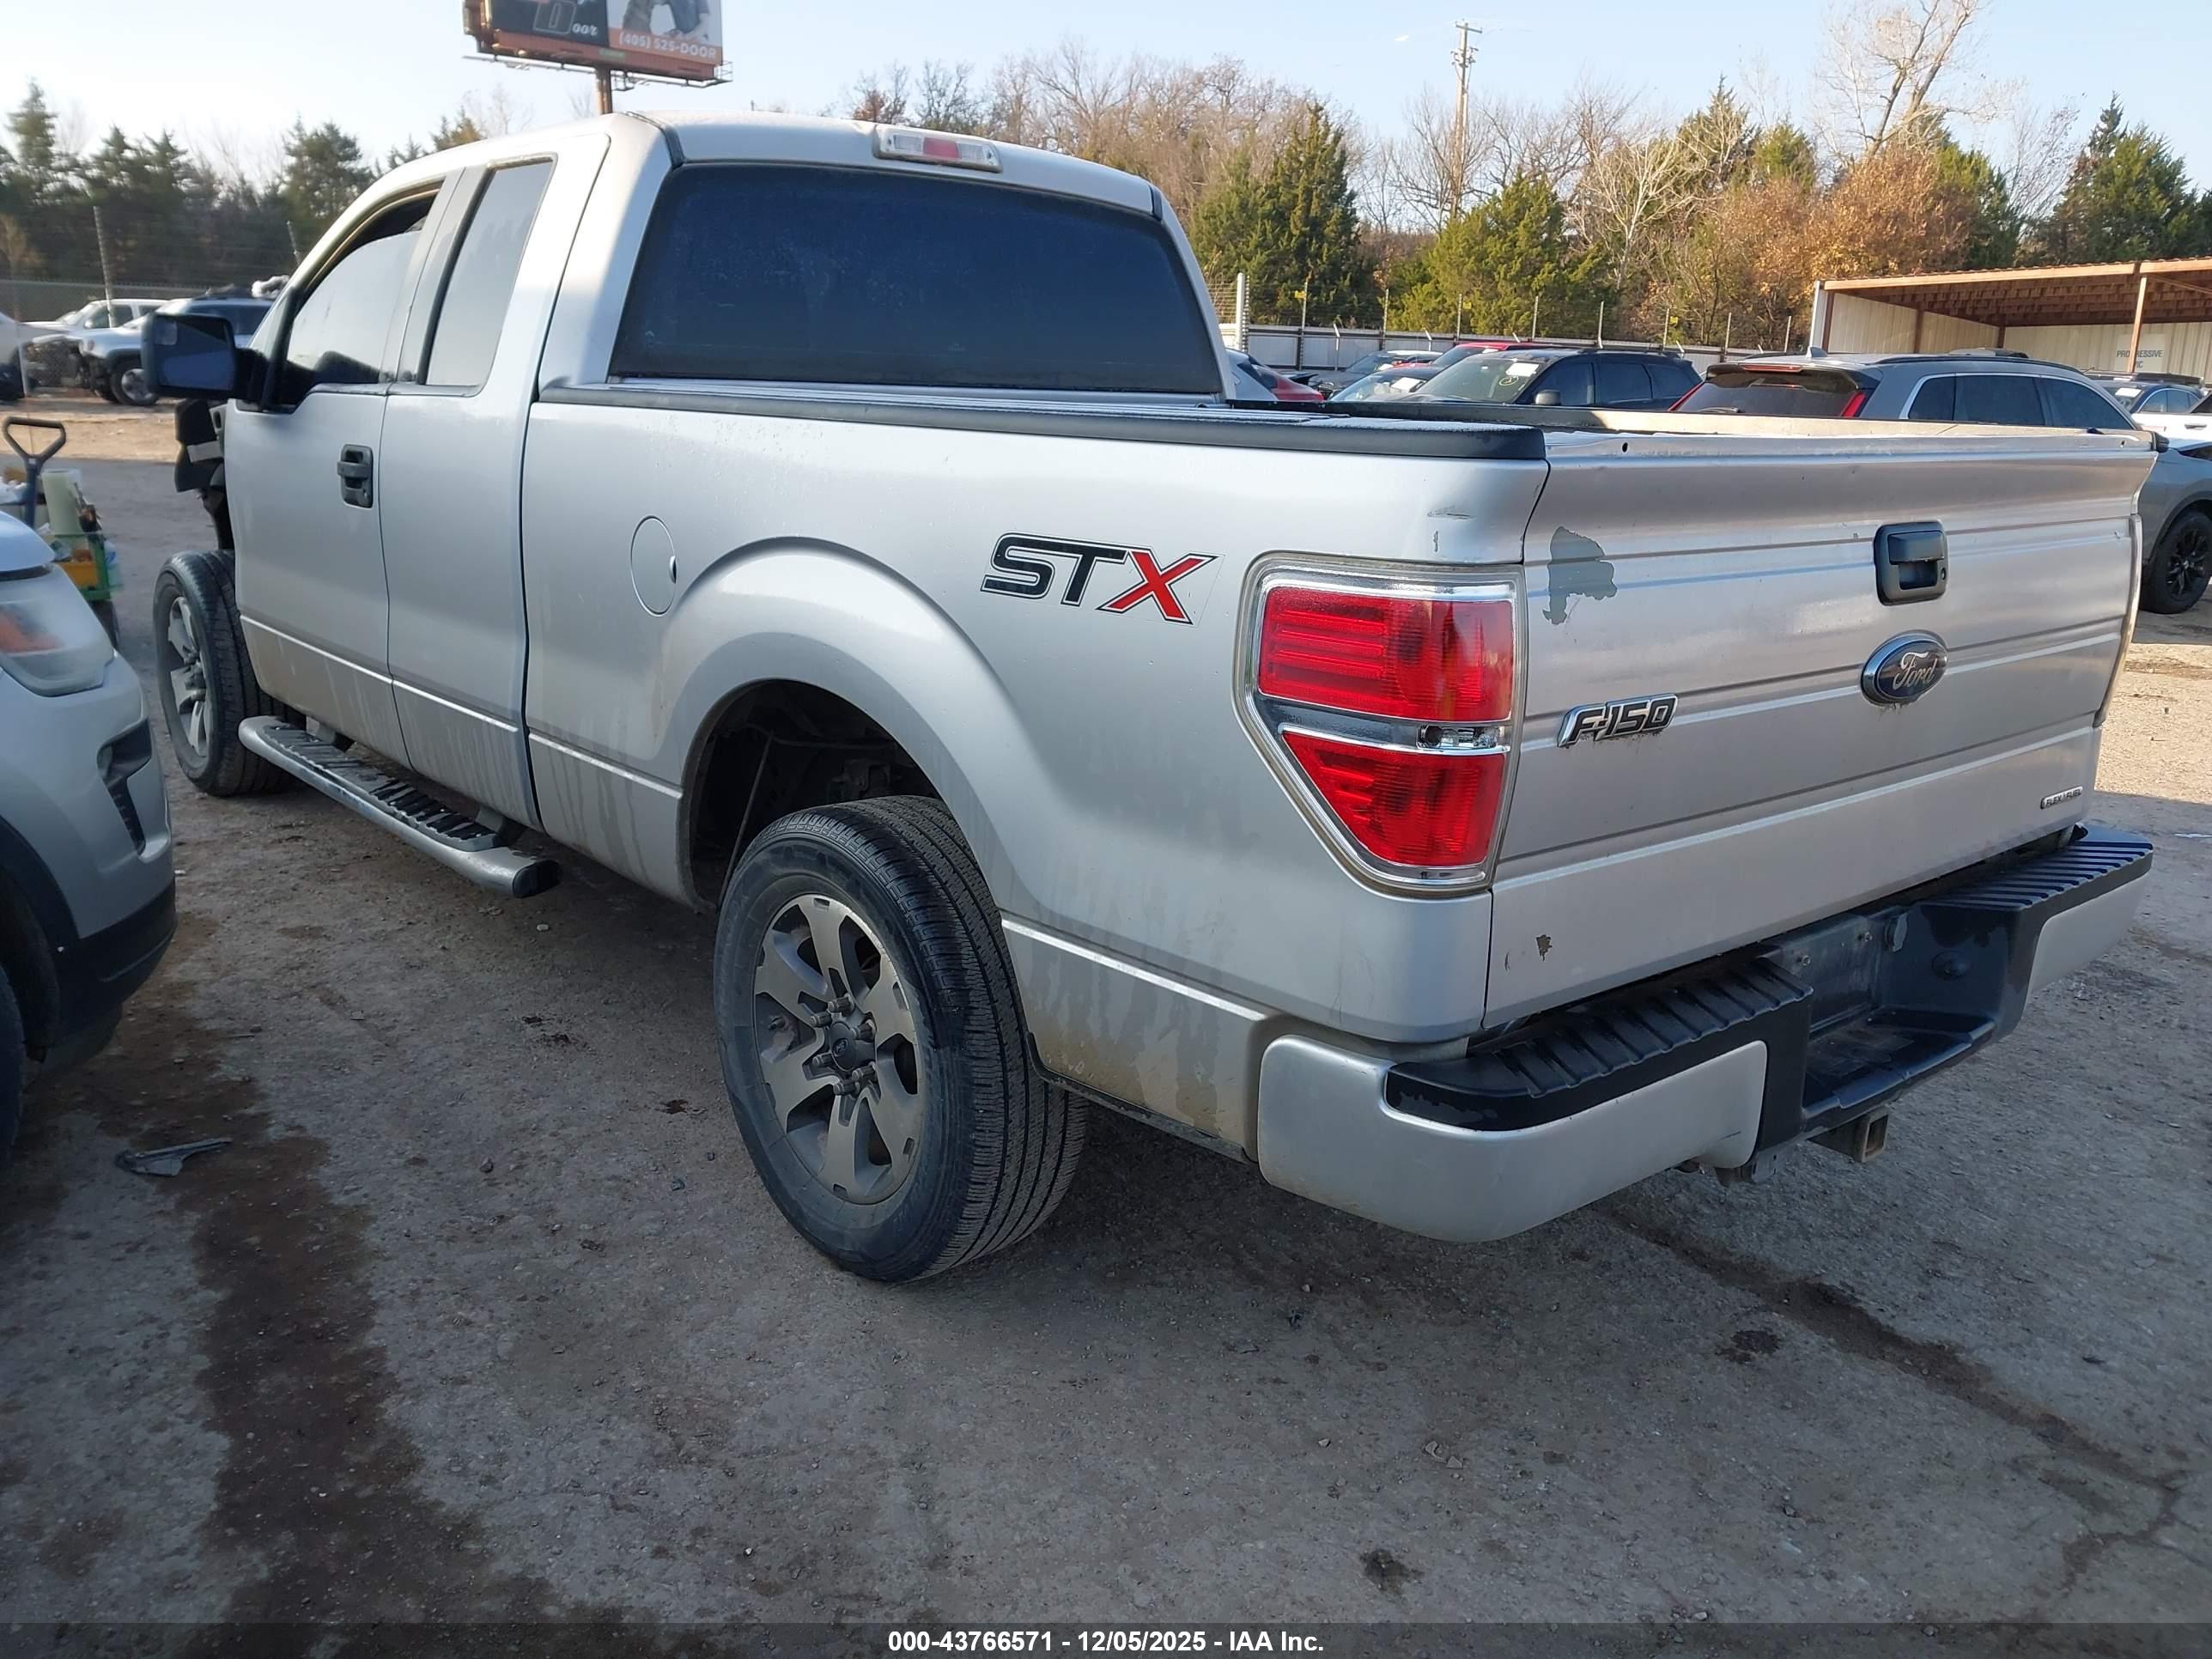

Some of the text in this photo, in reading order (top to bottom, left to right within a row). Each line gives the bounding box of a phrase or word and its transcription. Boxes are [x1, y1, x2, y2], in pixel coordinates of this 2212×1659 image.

[618, 32, 716, 59] (405) 525-DOOR
[980, 532, 1220, 625] STX
[1893, 651, 1939, 690] Ford
[1556, 692, 1679, 748] F-150
[2046, 789, 2081, 806] FLEX FUEL
